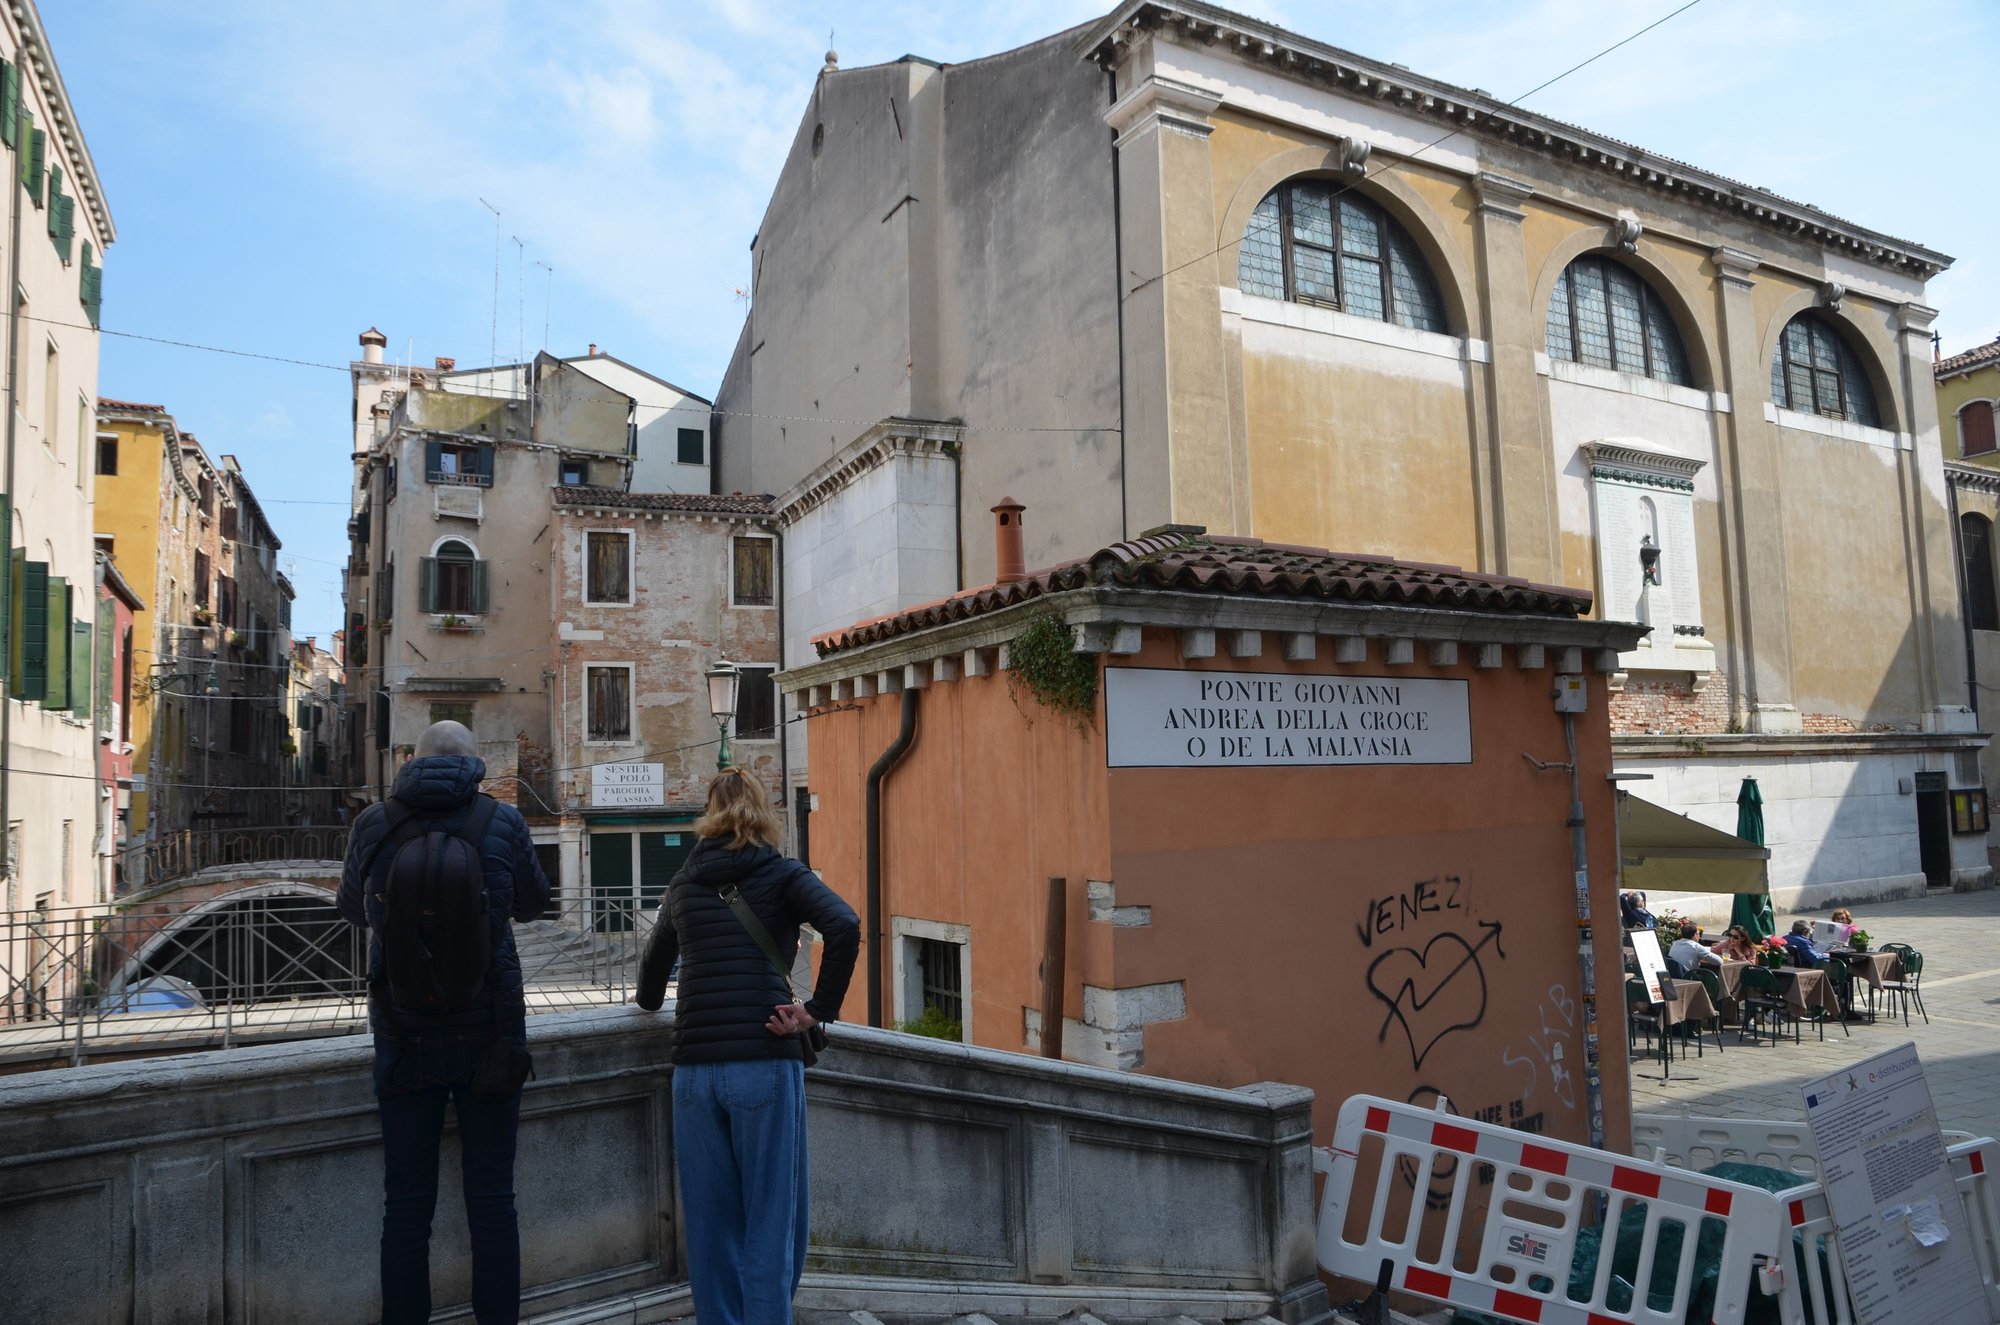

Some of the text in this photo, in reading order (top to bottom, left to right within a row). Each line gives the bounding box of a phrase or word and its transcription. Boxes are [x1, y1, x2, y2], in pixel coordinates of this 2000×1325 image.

[1200, 679, 1401, 706] PONTE GIOVANNI
[1164, 707, 1429, 731] ANDREA DELLA CROCE
[1187, 735, 1412, 758] O DE LA MALVASIA
[605, 765, 649, 773] SESTIER
[620, 774, 651, 783] POLO
[604, 787, 650, 795] PAROCHIA
[616, 796, 655, 804] CASSIAN
